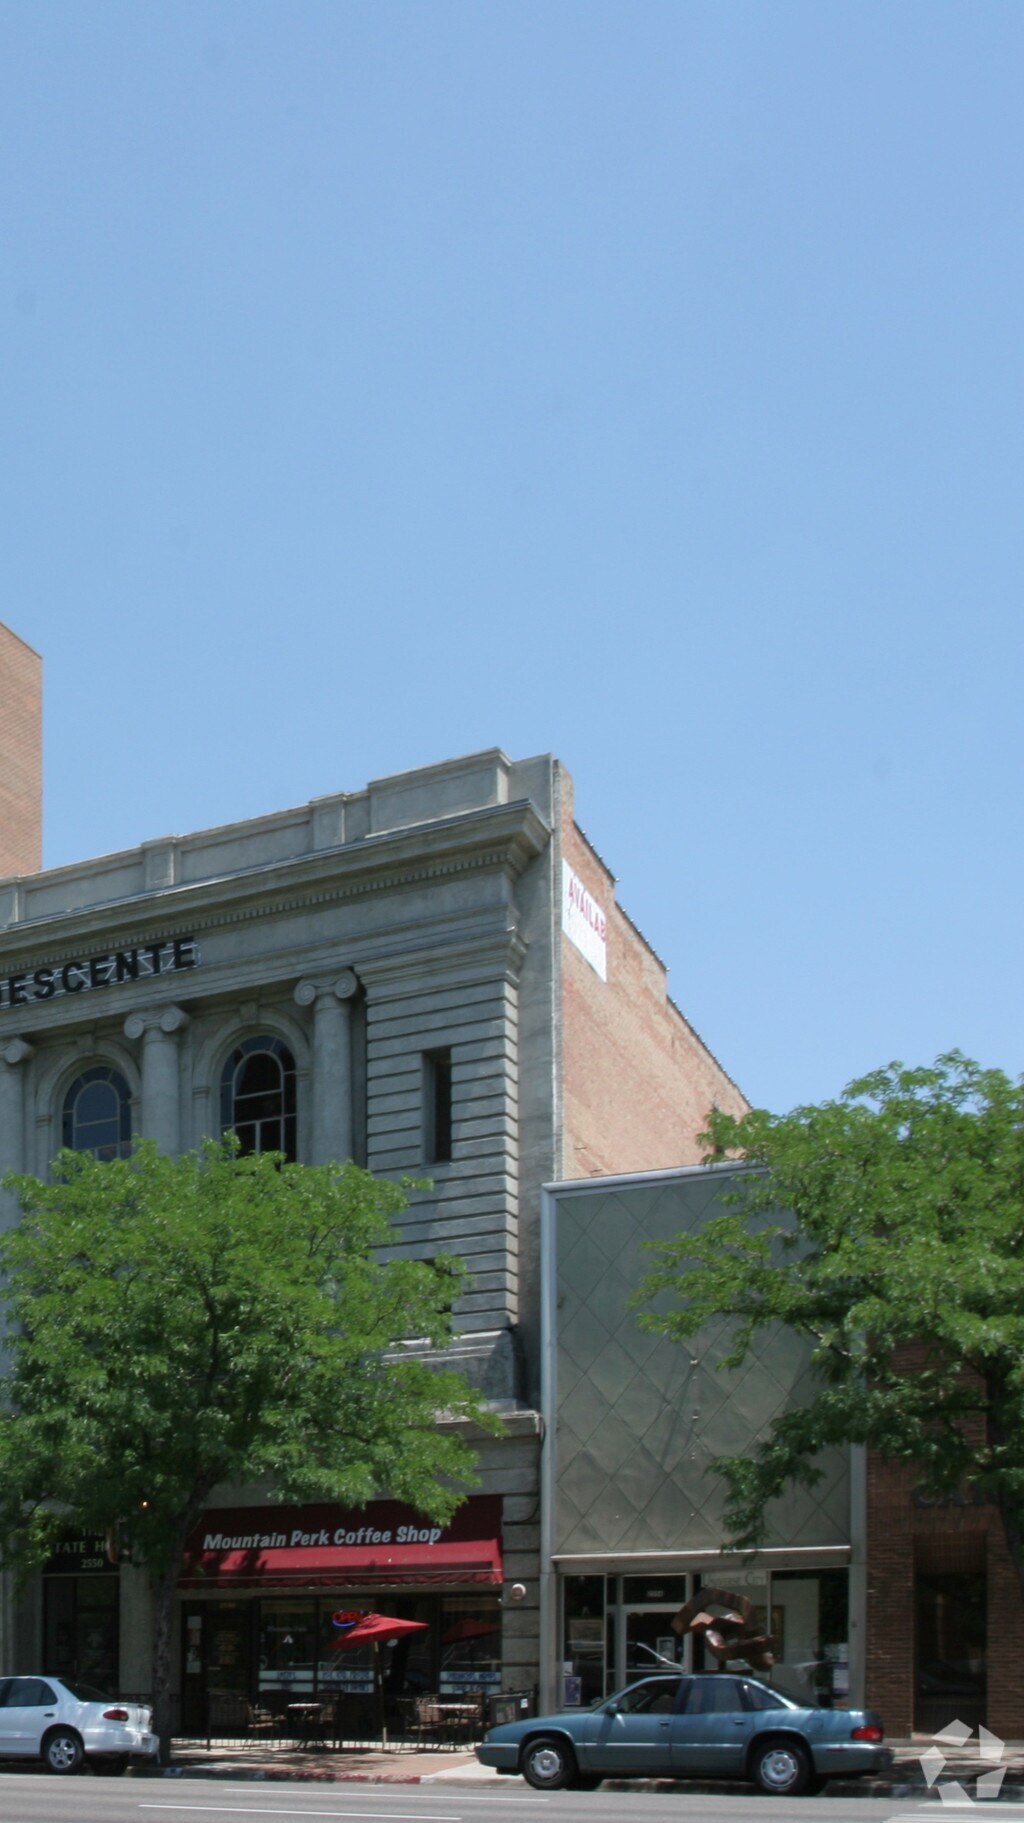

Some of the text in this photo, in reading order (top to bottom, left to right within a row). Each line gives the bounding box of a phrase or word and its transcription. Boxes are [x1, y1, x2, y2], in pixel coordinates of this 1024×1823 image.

[203, 1525, 442, 1550] Mountain Perk Coffee Shop
[49, 1540, 86, 1554] TATE
[80, 1558, 104, 1569] 2550
